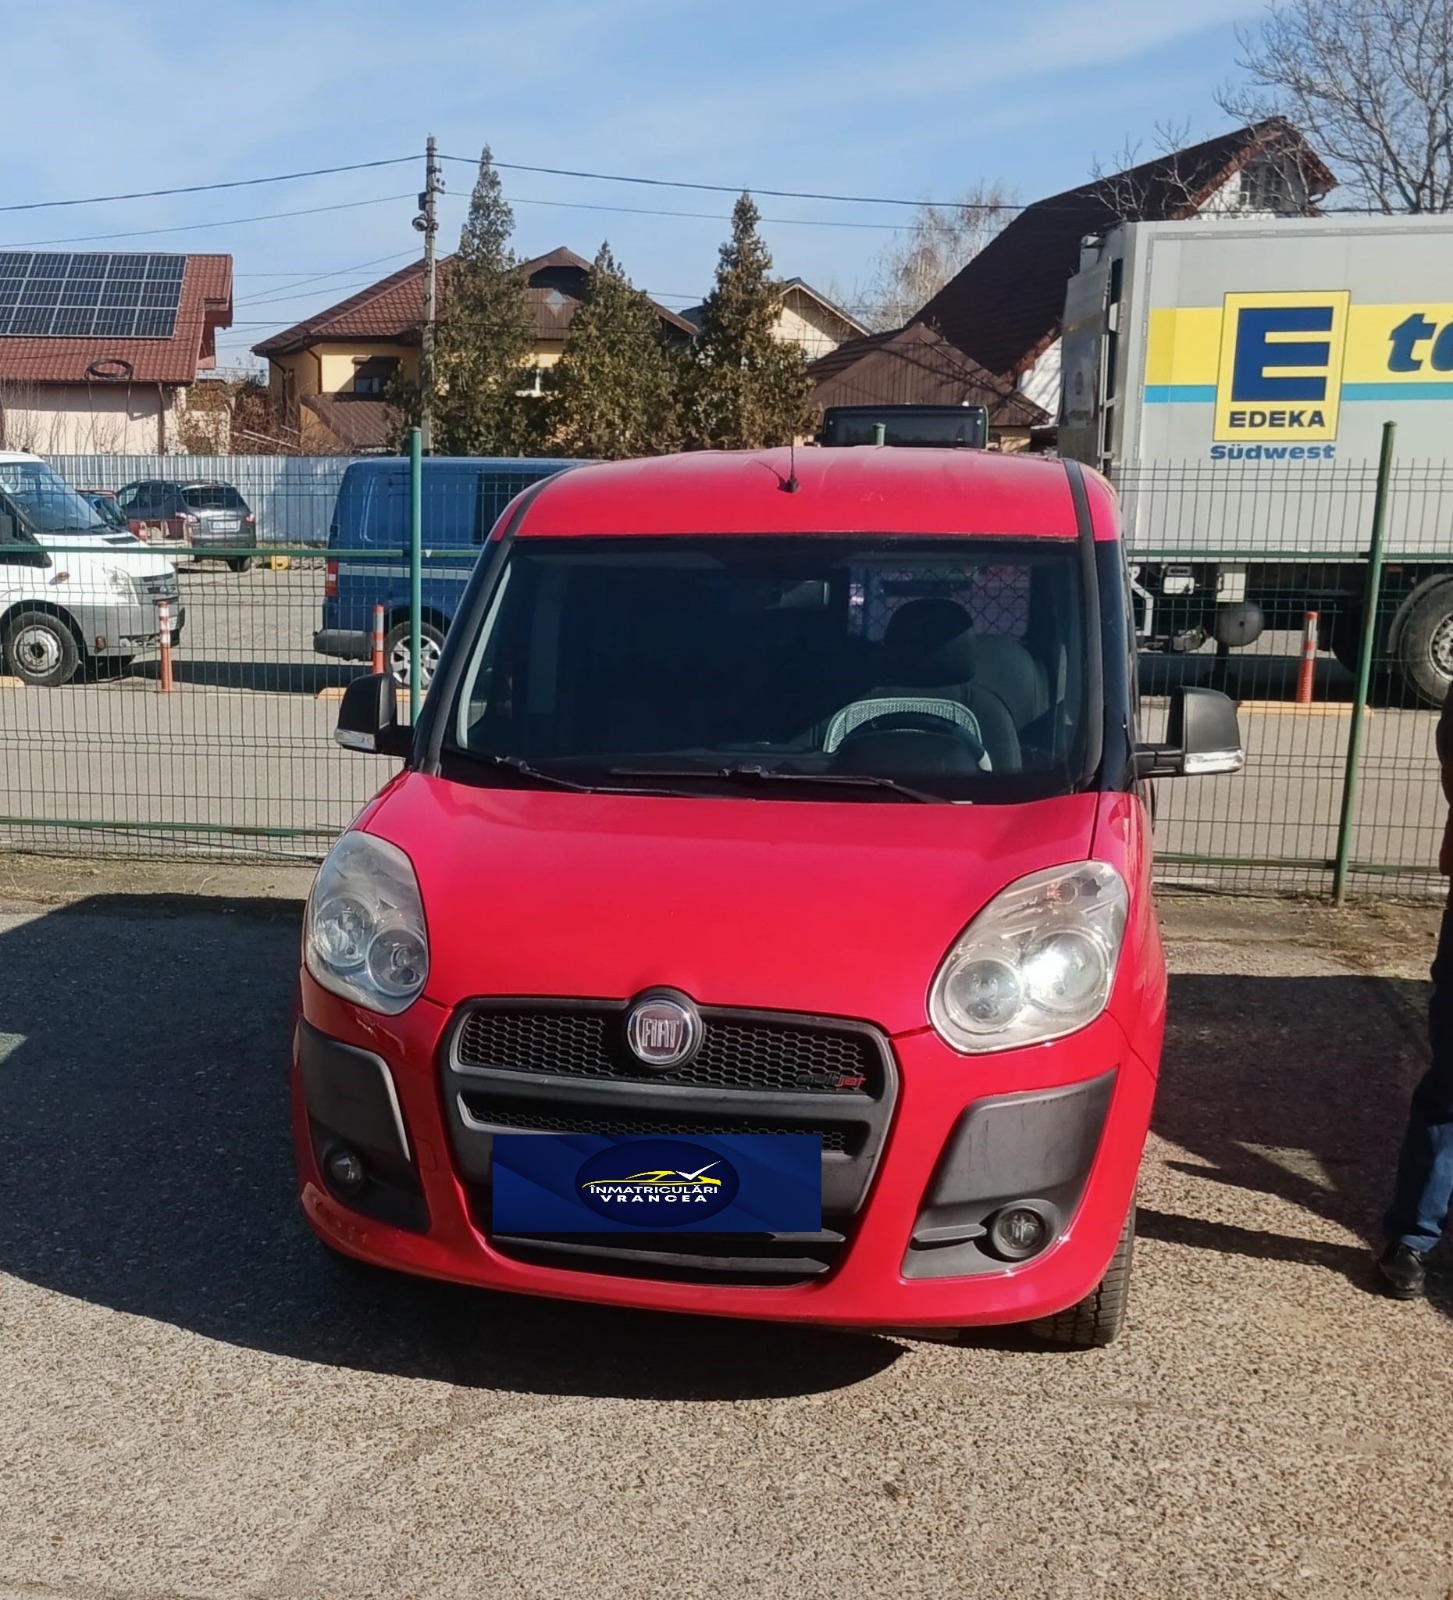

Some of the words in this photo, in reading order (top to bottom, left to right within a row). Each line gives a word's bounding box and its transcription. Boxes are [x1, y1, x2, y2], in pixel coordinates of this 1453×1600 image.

[1231, 306, 1334, 402] E
[1229, 410, 1326, 428] EDEKA
[1210, 444, 1336, 460] Südwest
[641, 1018, 680, 1048] FIAT
